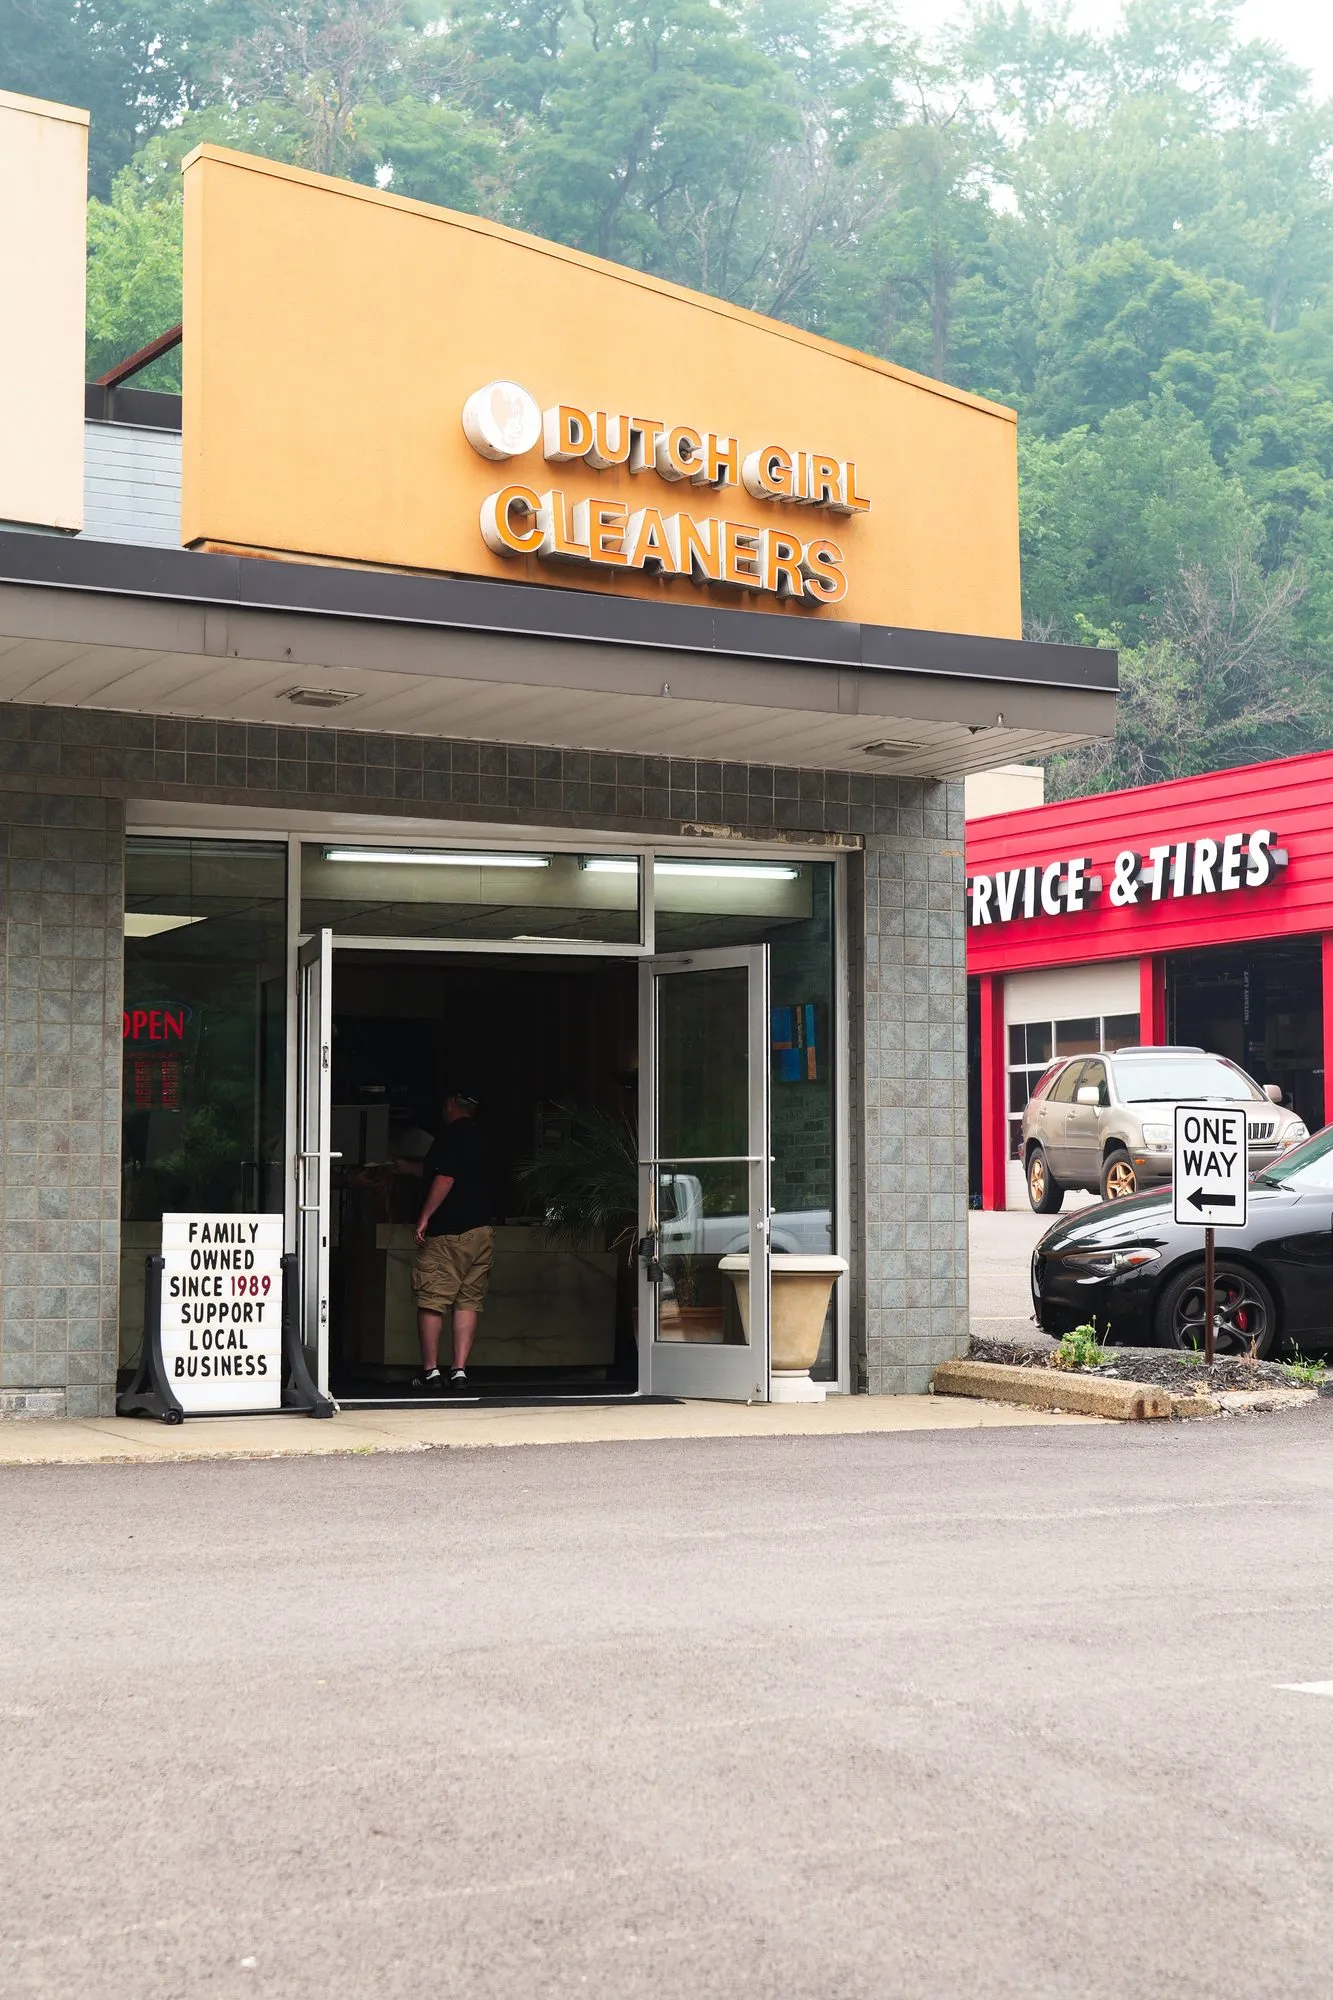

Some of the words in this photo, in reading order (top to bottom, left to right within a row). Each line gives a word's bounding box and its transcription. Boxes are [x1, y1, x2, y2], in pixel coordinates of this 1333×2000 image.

[553, 404, 740, 490] DUTCH
[755, 445, 872, 513] GIRL
[490, 484, 849, 605] CLEANERS
[965, 857, 1088, 926] RVICE
[1109, 850, 1140, 907] &
[1149, 829, 1276, 901] TIRES
[1184, 1116, 1238, 1145] ONE
[1183, 1149, 1238, 1178] WAY
[188, 1222, 259, 1244] FAMILY
[190, 1249, 254, 1270] OWNED
[169, 1275, 223, 1297] SINCE
[230, 1275, 272, 1297] 1989
[181, 1302, 265, 1324] SUPPORT
[189, 1328, 248, 1351] LOCAL
[174, 1354, 268, 1378] BUSINESS
